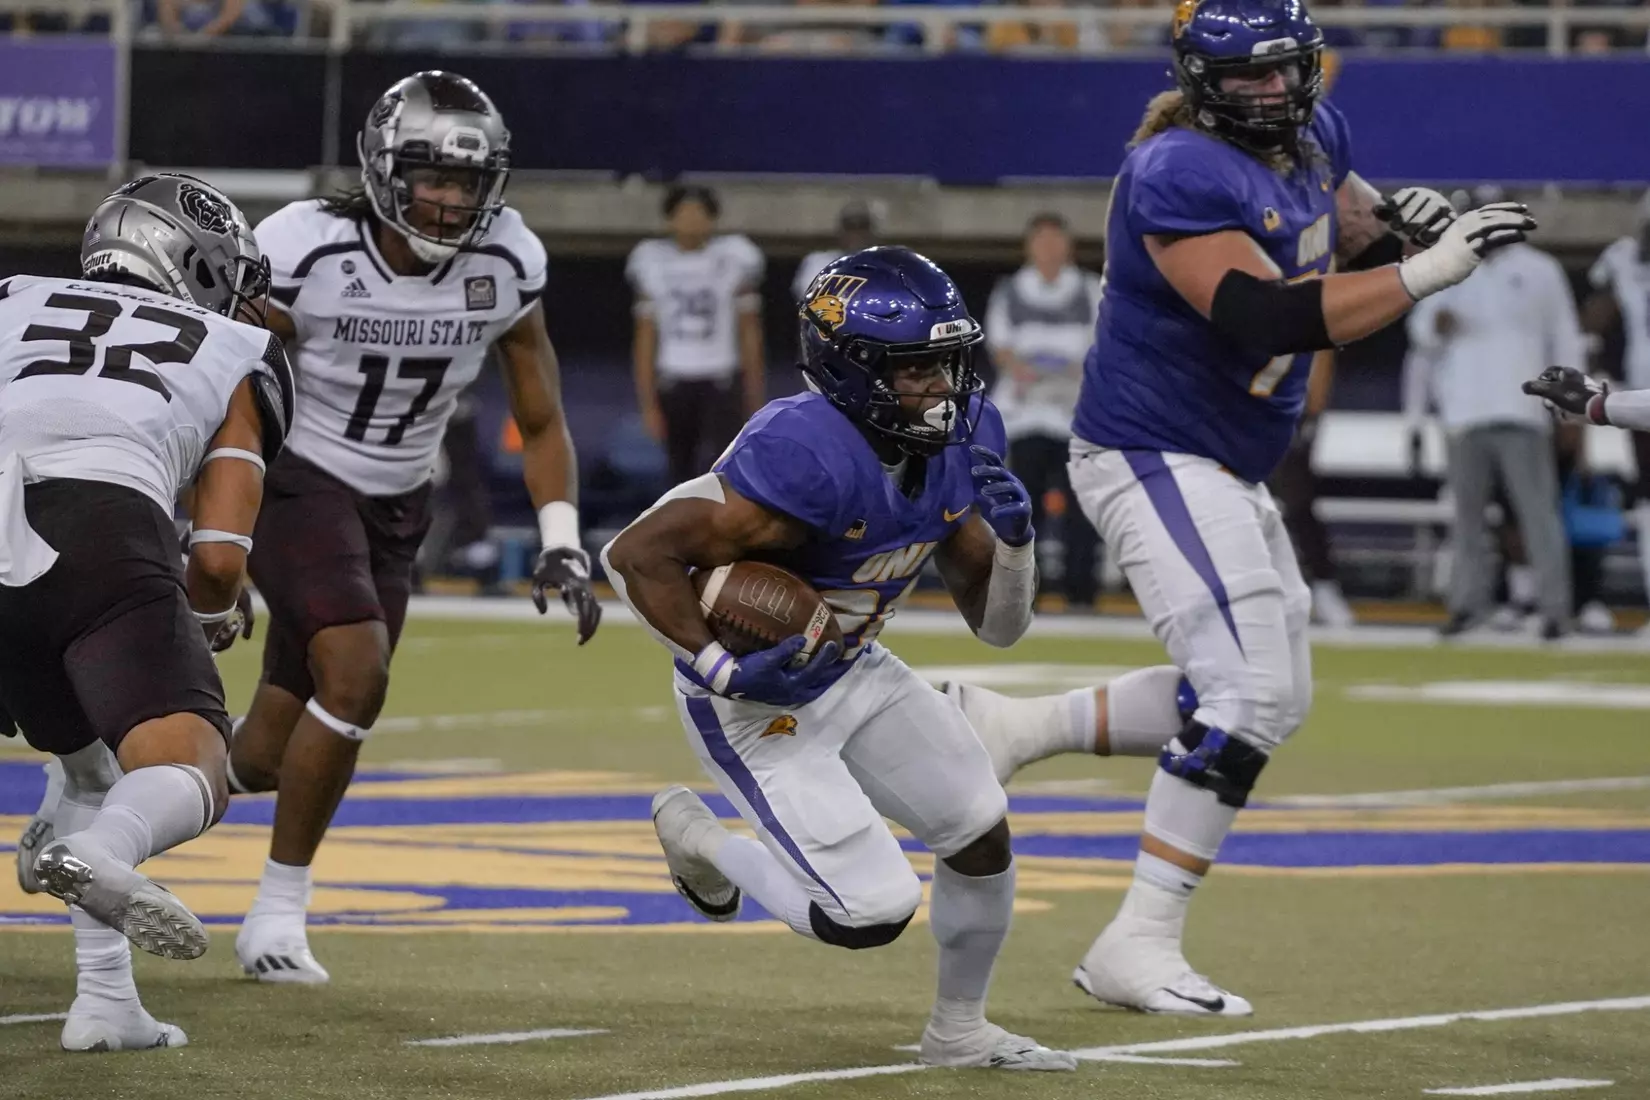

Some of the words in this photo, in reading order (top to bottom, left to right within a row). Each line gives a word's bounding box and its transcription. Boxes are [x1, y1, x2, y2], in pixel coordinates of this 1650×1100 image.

[11, 292, 208, 403] 32
[333, 317, 424, 345] MISSOURI
[429, 320, 489, 345] STATE
[343, 354, 453, 446] 17
